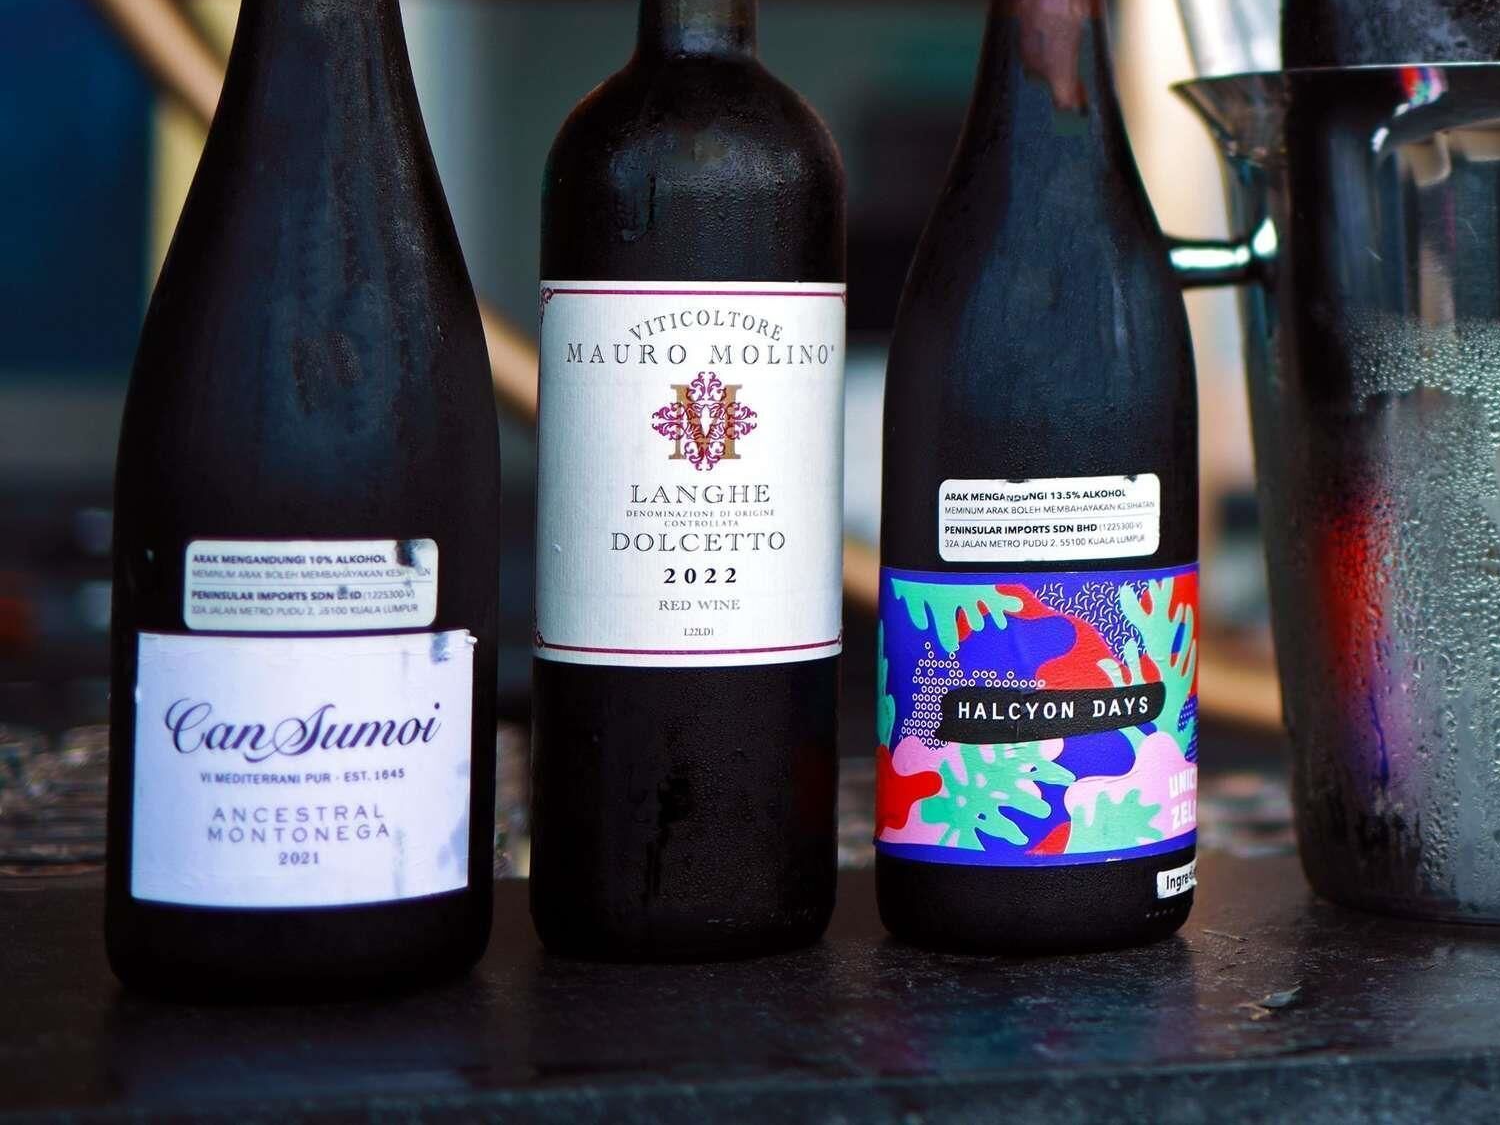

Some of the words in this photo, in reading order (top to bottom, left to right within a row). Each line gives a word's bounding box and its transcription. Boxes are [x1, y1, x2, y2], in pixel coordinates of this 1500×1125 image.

[629, 309, 783, 342] VITICOLTORE
[566, 343, 687, 365] MAURO
[630, 484, 771, 504] LANGHE
[945, 492, 968, 501] ARAK
[970, 492, 1047, 502] MENGANDUNGI
[1050, 491, 1081, 500] 13.5%
[1082, 489, 1127, 499] ALKOHOL
[626, 510, 714, 518] DENOMINAZIONE
[735, 509, 775, 517] ORIGINE
[945, 506, 984, 515] MEMINUM
[985, 506, 1009, 515] ARAK
[1011, 506, 1041, 515] BOLEH
[1043, 503, 1116, 514] MEMBAHAYAKAN
[664, 520, 739, 528] CONTROLLATA
[945, 525, 1002, 535] PENINSULAR
[1005, 525, 1050, 534] IMPORTS
[1053, 524, 1074, 533] SDN
[1076, 524, 1098, 533] BHD
[611, 531, 786, 553] DOLCETTO
[944, 539, 960, 548] 32A
[961, 539, 987, 548] JALAN
[989, 539, 1021, 548] METRO
[1023, 538, 1049, 547] PUDU
[1060, 537, 1086, 546] 55100
[1088, 536, 1115, 546] KUALA
[192, 554, 219, 564] ARAK
[222, 555, 306, 565] MENGANDUNGI
[309, 555, 333, 565] 10%
[335, 554, 387, 564] ALKOHOL
[663, 567, 738, 585] 2022
[192, 590, 253, 600] PENINSULAR
[256, 591, 308, 601] IMPORTS
[311, 591, 334, 601] SDN
[658, 599, 692, 612] RED
[698, 598, 741, 611] WINE
[957, 701, 1075, 721] HALCYON
[1092, 696, 1150, 718] DAYS
[165, 698, 271, 754] Can
[244, 702, 441, 763] Sumoi
[200, 772, 212, 783] VI
[214, 772, 300, 785] MEDITERRANI
[304, 772, 331, 784] PUR
[343, 770, 371, 783] EST.
[374, 768, 405, 781] 1645
[212, 804, 385, 824] ANCESTRAL
[208, 824, 390, 844] MONTONEGA
[278, 851, 320, 866] 2021
